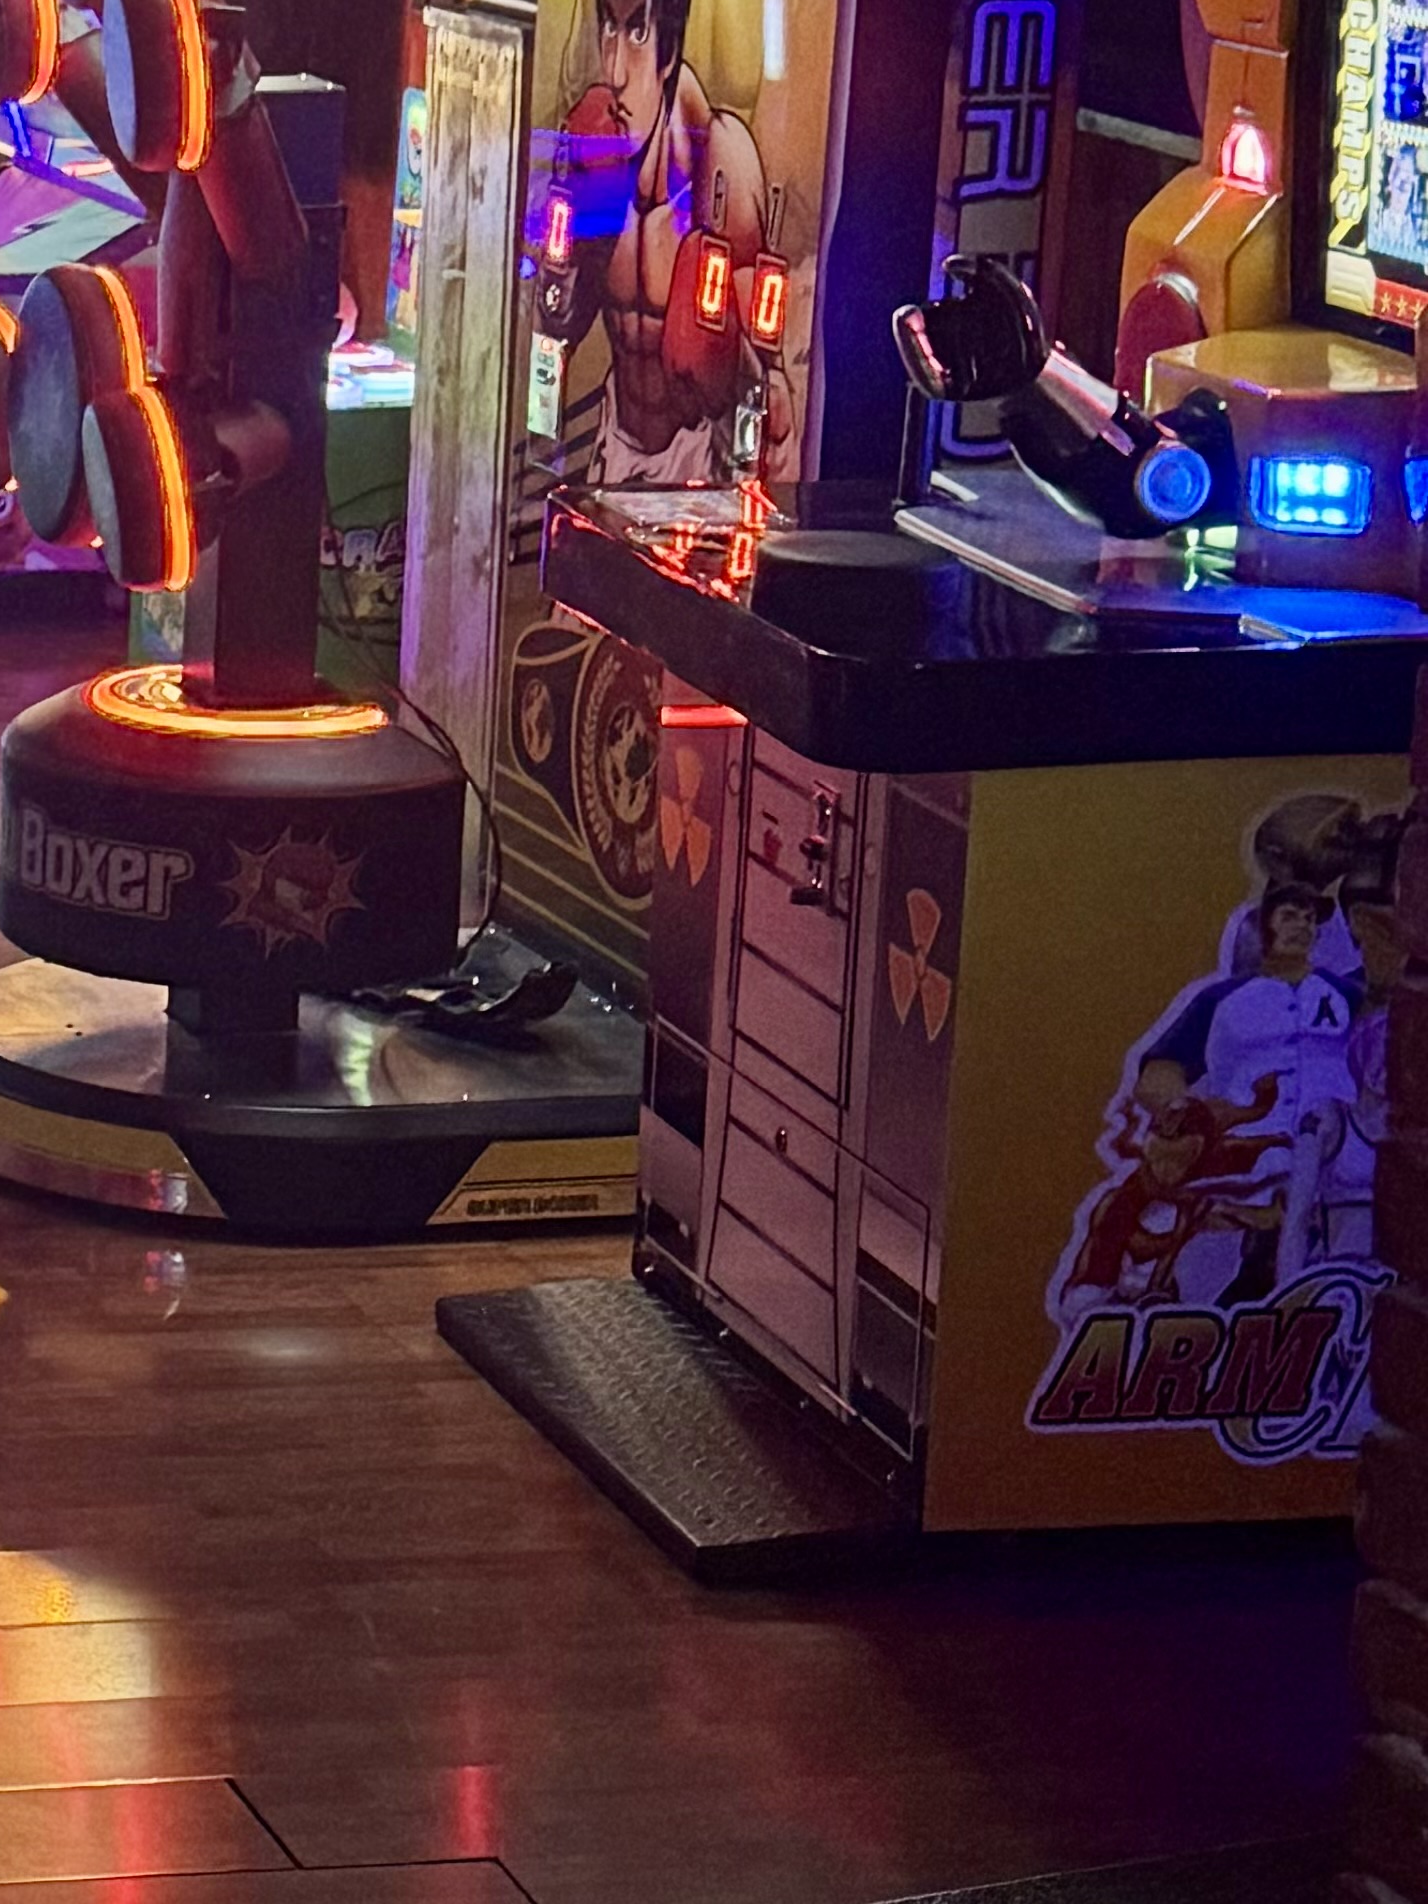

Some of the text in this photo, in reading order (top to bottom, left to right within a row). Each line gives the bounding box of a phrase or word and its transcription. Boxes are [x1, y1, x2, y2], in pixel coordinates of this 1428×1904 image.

[702, 256, 725, 313] 0
[757, 275, 783, 333] 0
[20, 806, 189, 915] Boxer
[1032, 1312, 1341, 1425] ARM
